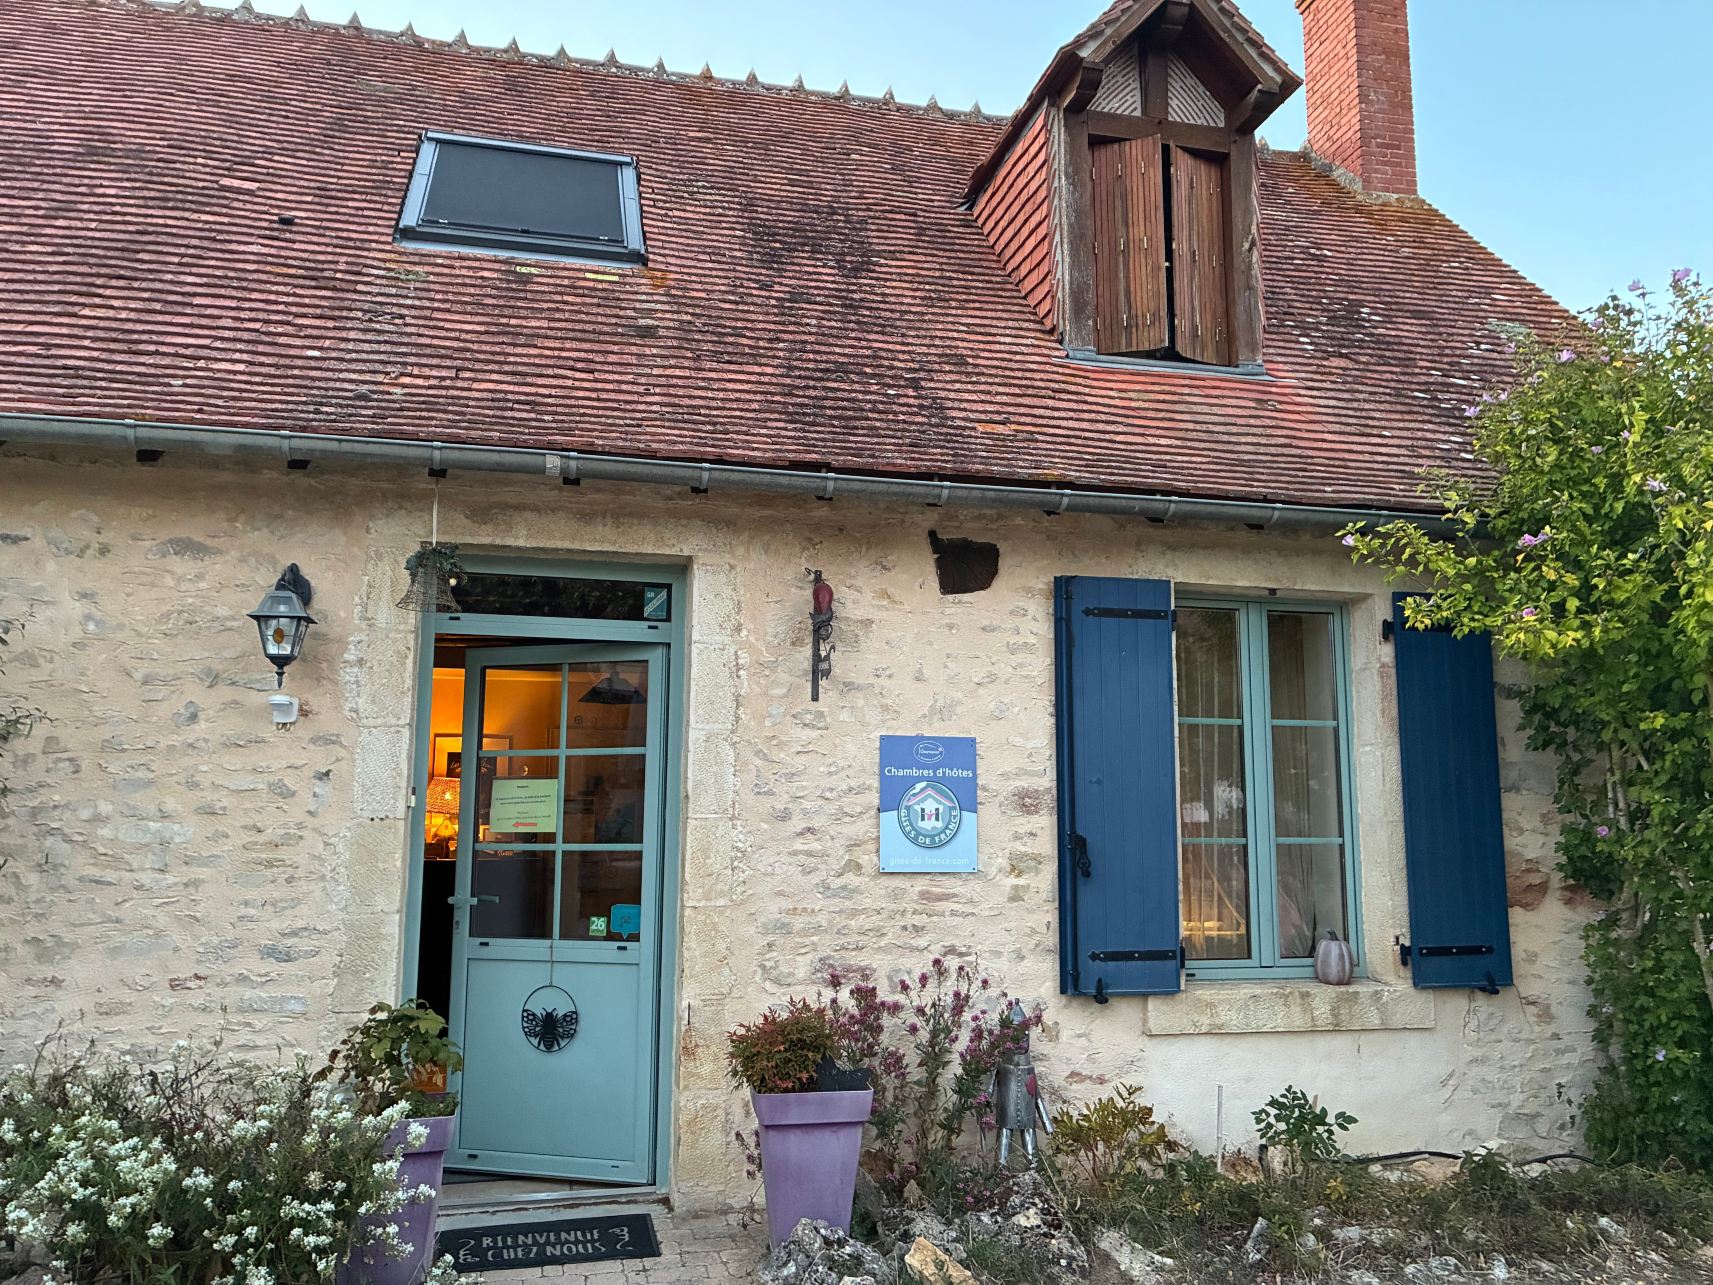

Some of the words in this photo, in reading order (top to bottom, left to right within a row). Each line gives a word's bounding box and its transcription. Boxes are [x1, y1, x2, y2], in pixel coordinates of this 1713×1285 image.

[884, 766, 934, 777] Chambres
[936, 767, 973, 778] d'hôtes
[918, 836, 931, 845] DE
[934, 809, 958, 844] FRANCE
[591, 917, 605, 930] 26
[481, 1229, 601, 1248] BIENVENUE
[487, 1246, 537, 1261] CHEZ
[546, 1242, 607, 1257] NOUS
